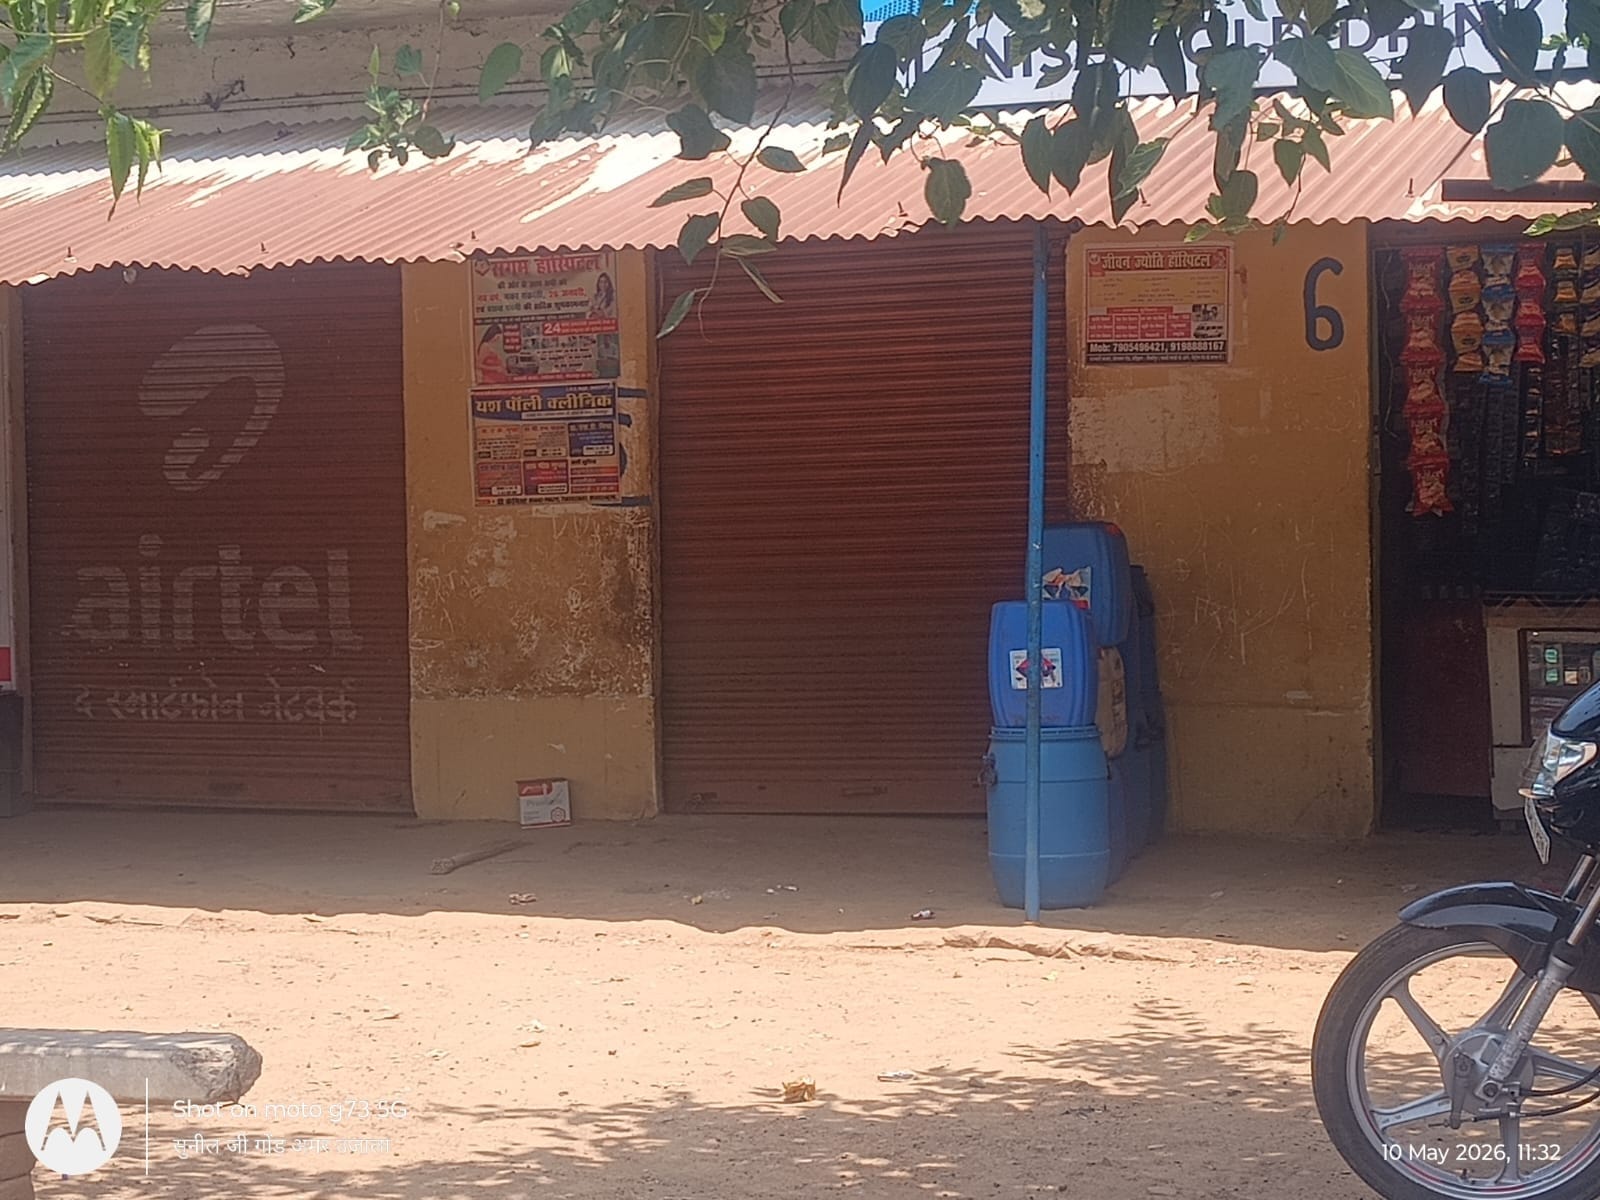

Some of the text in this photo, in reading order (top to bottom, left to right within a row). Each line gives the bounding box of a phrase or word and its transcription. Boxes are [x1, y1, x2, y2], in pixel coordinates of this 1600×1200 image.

[1102, 252, 1131, 270] जीवन
[1135, 251, 1164, 269] ज्योति
[1304, 256, 1345, 352] 6
[544, 324, 561, 335] 24
[1089, 343, 1111, 353] Mob:
[476, 400, 501, 413] यश
[506, 395, 542, 410] पॉली
[71, 533, 364, 652] airtel
